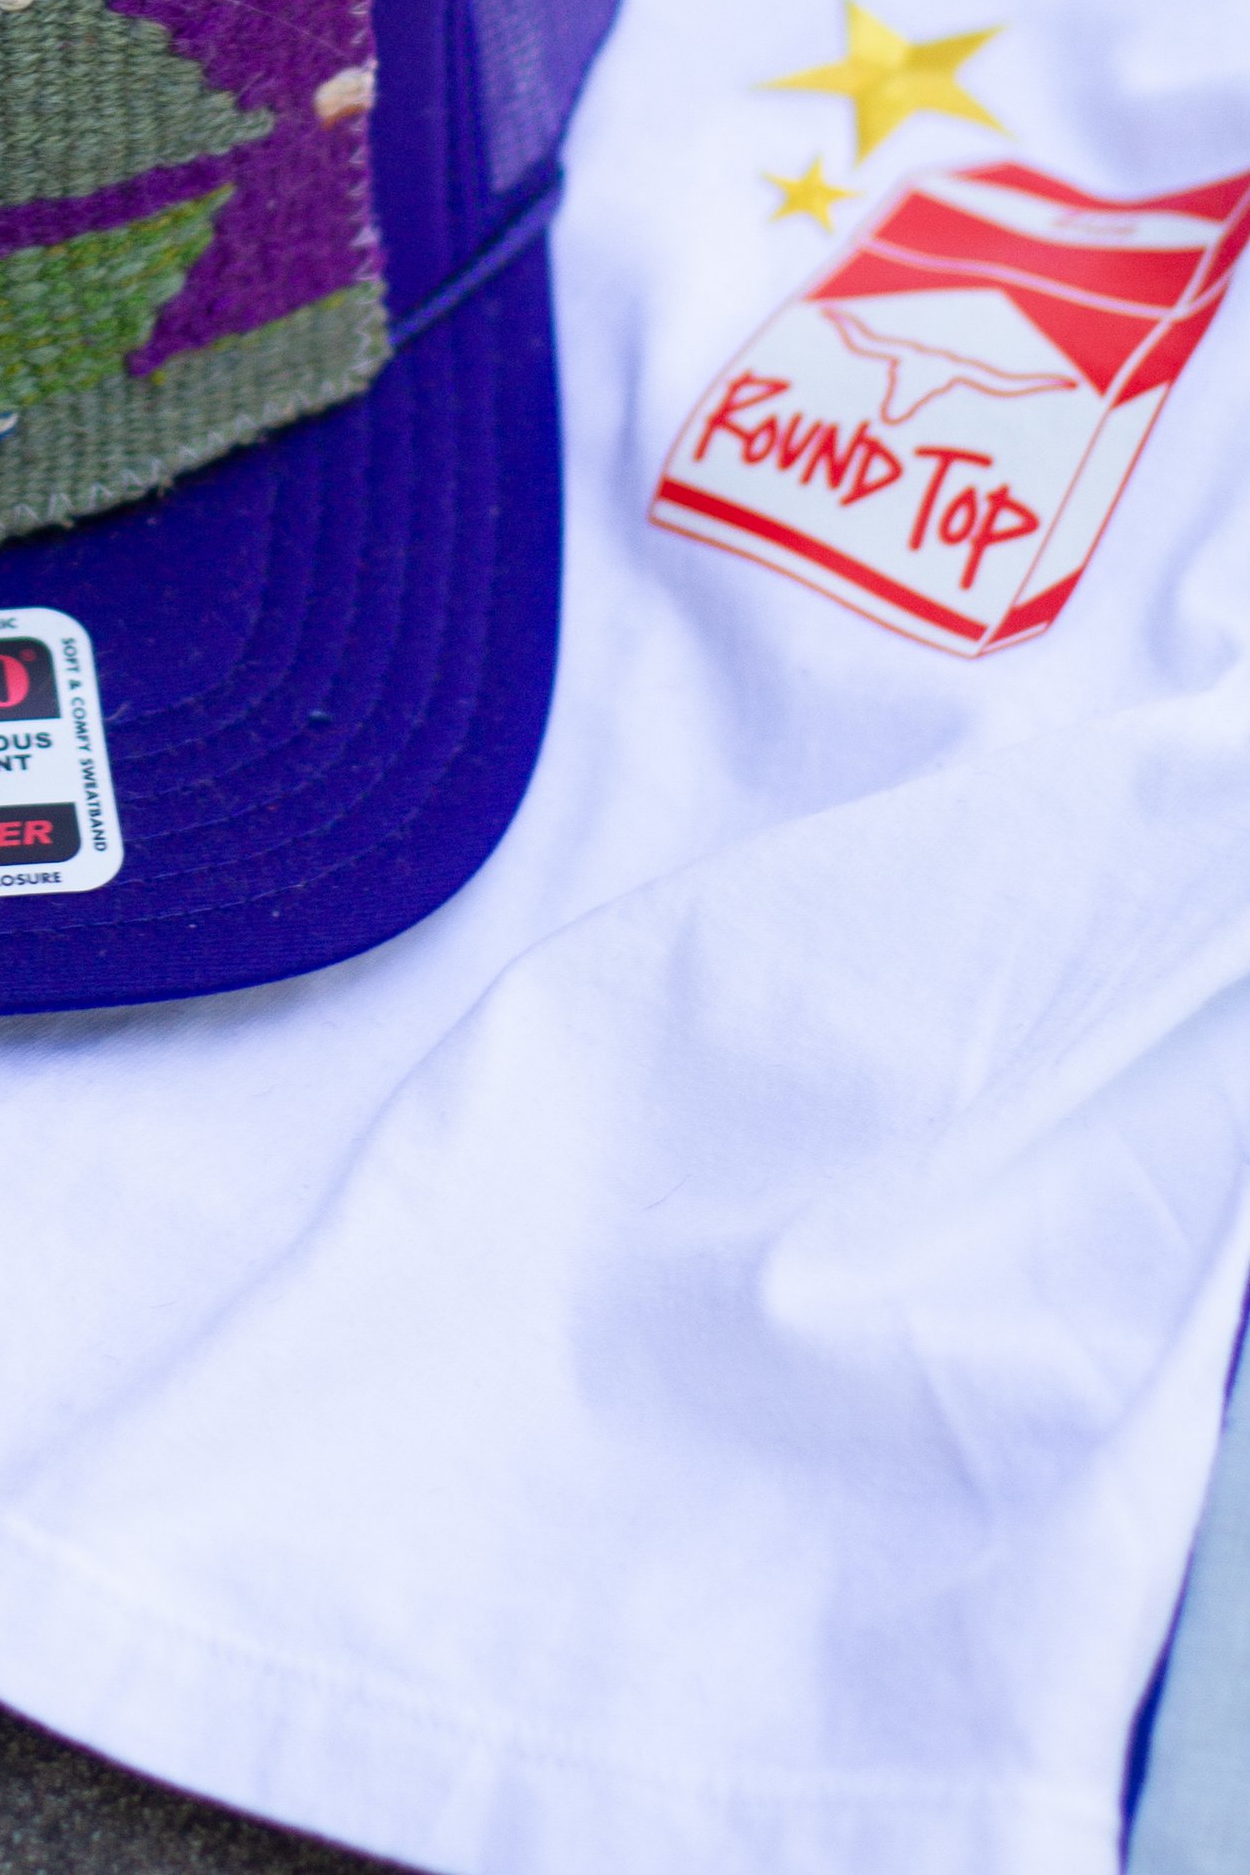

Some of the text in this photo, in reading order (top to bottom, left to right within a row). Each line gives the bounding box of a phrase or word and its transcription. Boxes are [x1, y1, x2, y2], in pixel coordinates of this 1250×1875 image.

[691, 369, 1041, 590] ROUND TOP
[61, 636, 108, 853] SOFT & COMFY SWEATBAND
